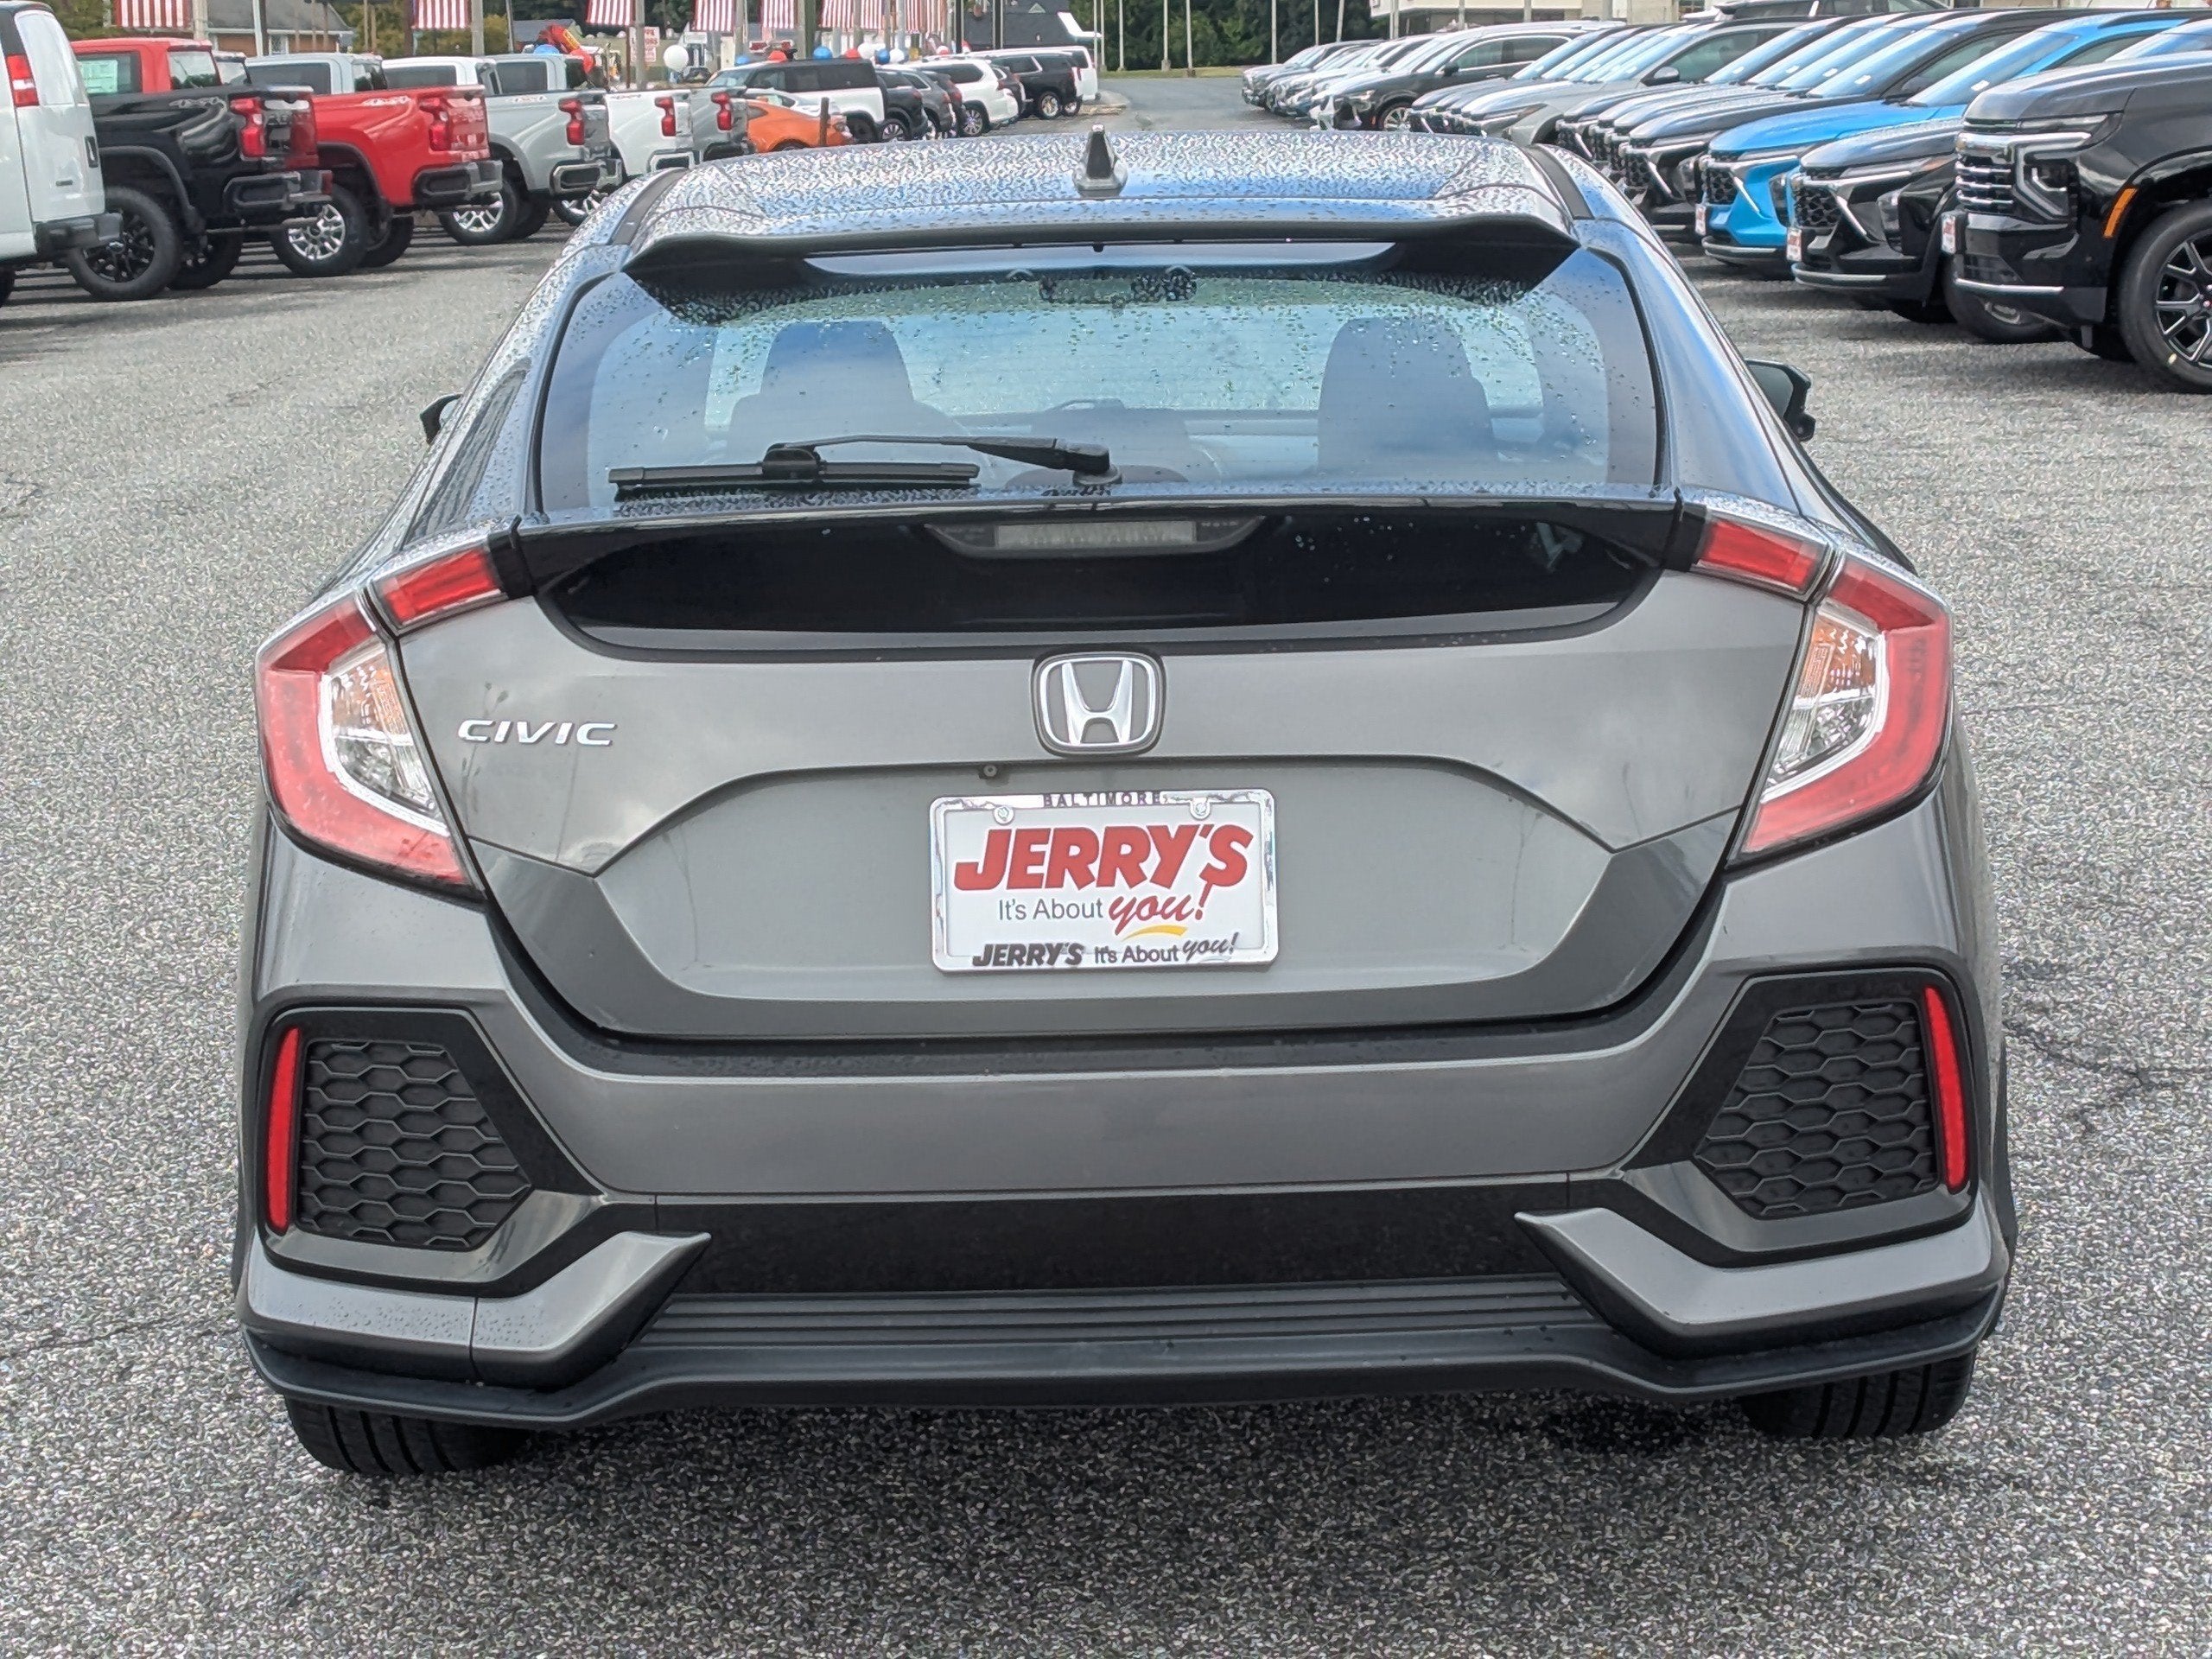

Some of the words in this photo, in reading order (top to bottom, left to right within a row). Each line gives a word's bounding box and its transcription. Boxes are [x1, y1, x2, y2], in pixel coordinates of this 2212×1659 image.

[457, 719, 618, 746] CIVIC
[1044, 791, 1160, 809] BALTIMORE
[954, 823, 1254, 891] JERRY'S
[999, 899, 1027, 920] It's
[1033, 898, 1103, 919] About
[1109, 884, 1212, 936] you!
[972, 942, 1085, 967] JERRY'S
[1093, 945, 1117, 964] It's
[1122, 944, 1179, 963] About
[1183, 931, 1239, 962] you!
